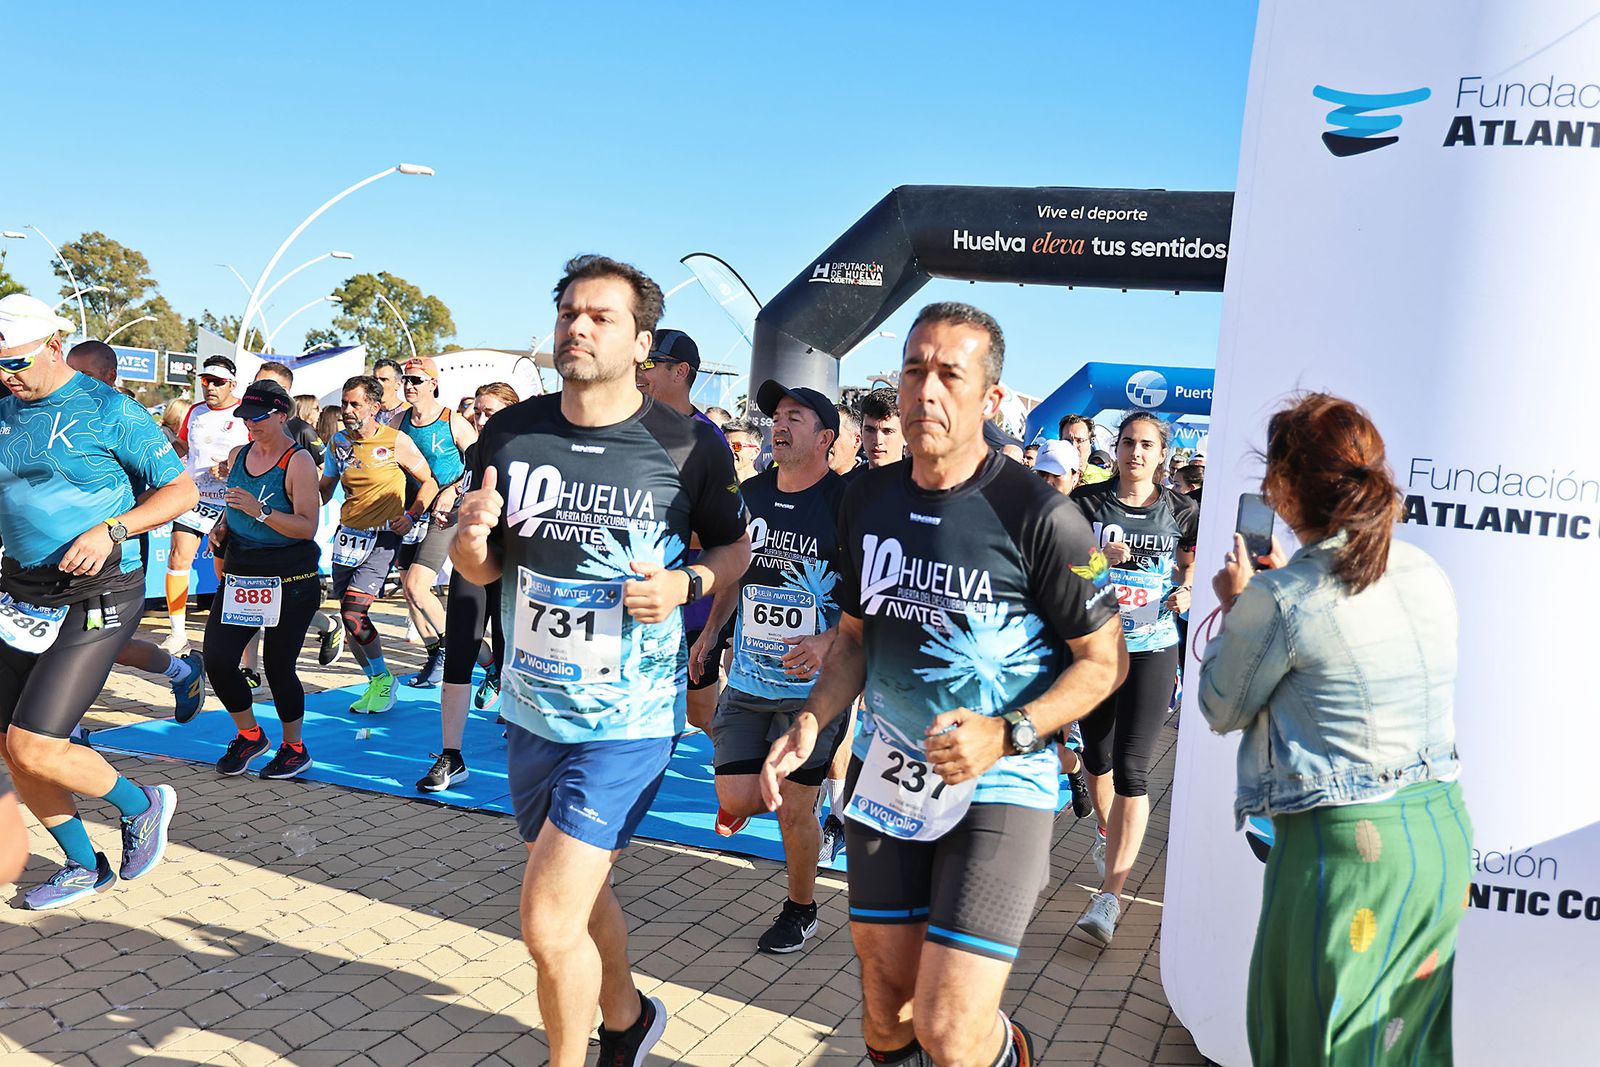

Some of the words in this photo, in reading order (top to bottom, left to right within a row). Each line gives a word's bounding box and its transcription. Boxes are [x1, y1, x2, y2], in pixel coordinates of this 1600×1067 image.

[1037, 205, 1067, 218] Vive
[1071, 206, 1084, 219] el
[1087, 206, 1148, 223] deporte
[953, 229, 1026, 252] Huelva
[1032, 231, 1085, 255] eleva
[1091, 236, 1126, 256] tus
[830, 270, 841, 278] DE
[845, 270, 883, 281] HUELVA
[831, 261, 883, 273] DIPUTACIÓN
[117, 355, 150, 368] ATEC
[1175, 385, 1214, 400] Puert
[1408, 457, 1600, 504] Fundación
[557, 480, 655, 519] HUELVA
[555, 509, 580, 522] PUERTA
[580, 512, 593, 524] DEL
[1399, 494, 1592, 540] ATLANTIC
[339, 534, 367, 550] 911
[764, 528, 818, 557] HUELVA
[1122, 533, 1173, 551] HUELVA
[898, 556, 993, 601] HUELVA
[234, 588, 272, 604] 888
[553, 587, 591, 599] AVATEL
[773, 592, 797, 600] AVATEL
[797, 594, 812, 605] '24
[897, 588, 920, 600] PUERTA
[919, 591, 931, 604] DEL
[1117, 586, 1148, 607] 28
[0, 605, 50, 637] 886
[233, 614, 261, 622] Wayalia
[528, 600, 596, 642] 731
[753, 603, 803, 629] 650
[752, 639, 784, 651] Wayalia
[526, 654, 574, 676] Wayalia
[870, 802, 918, 832] Wayalia
